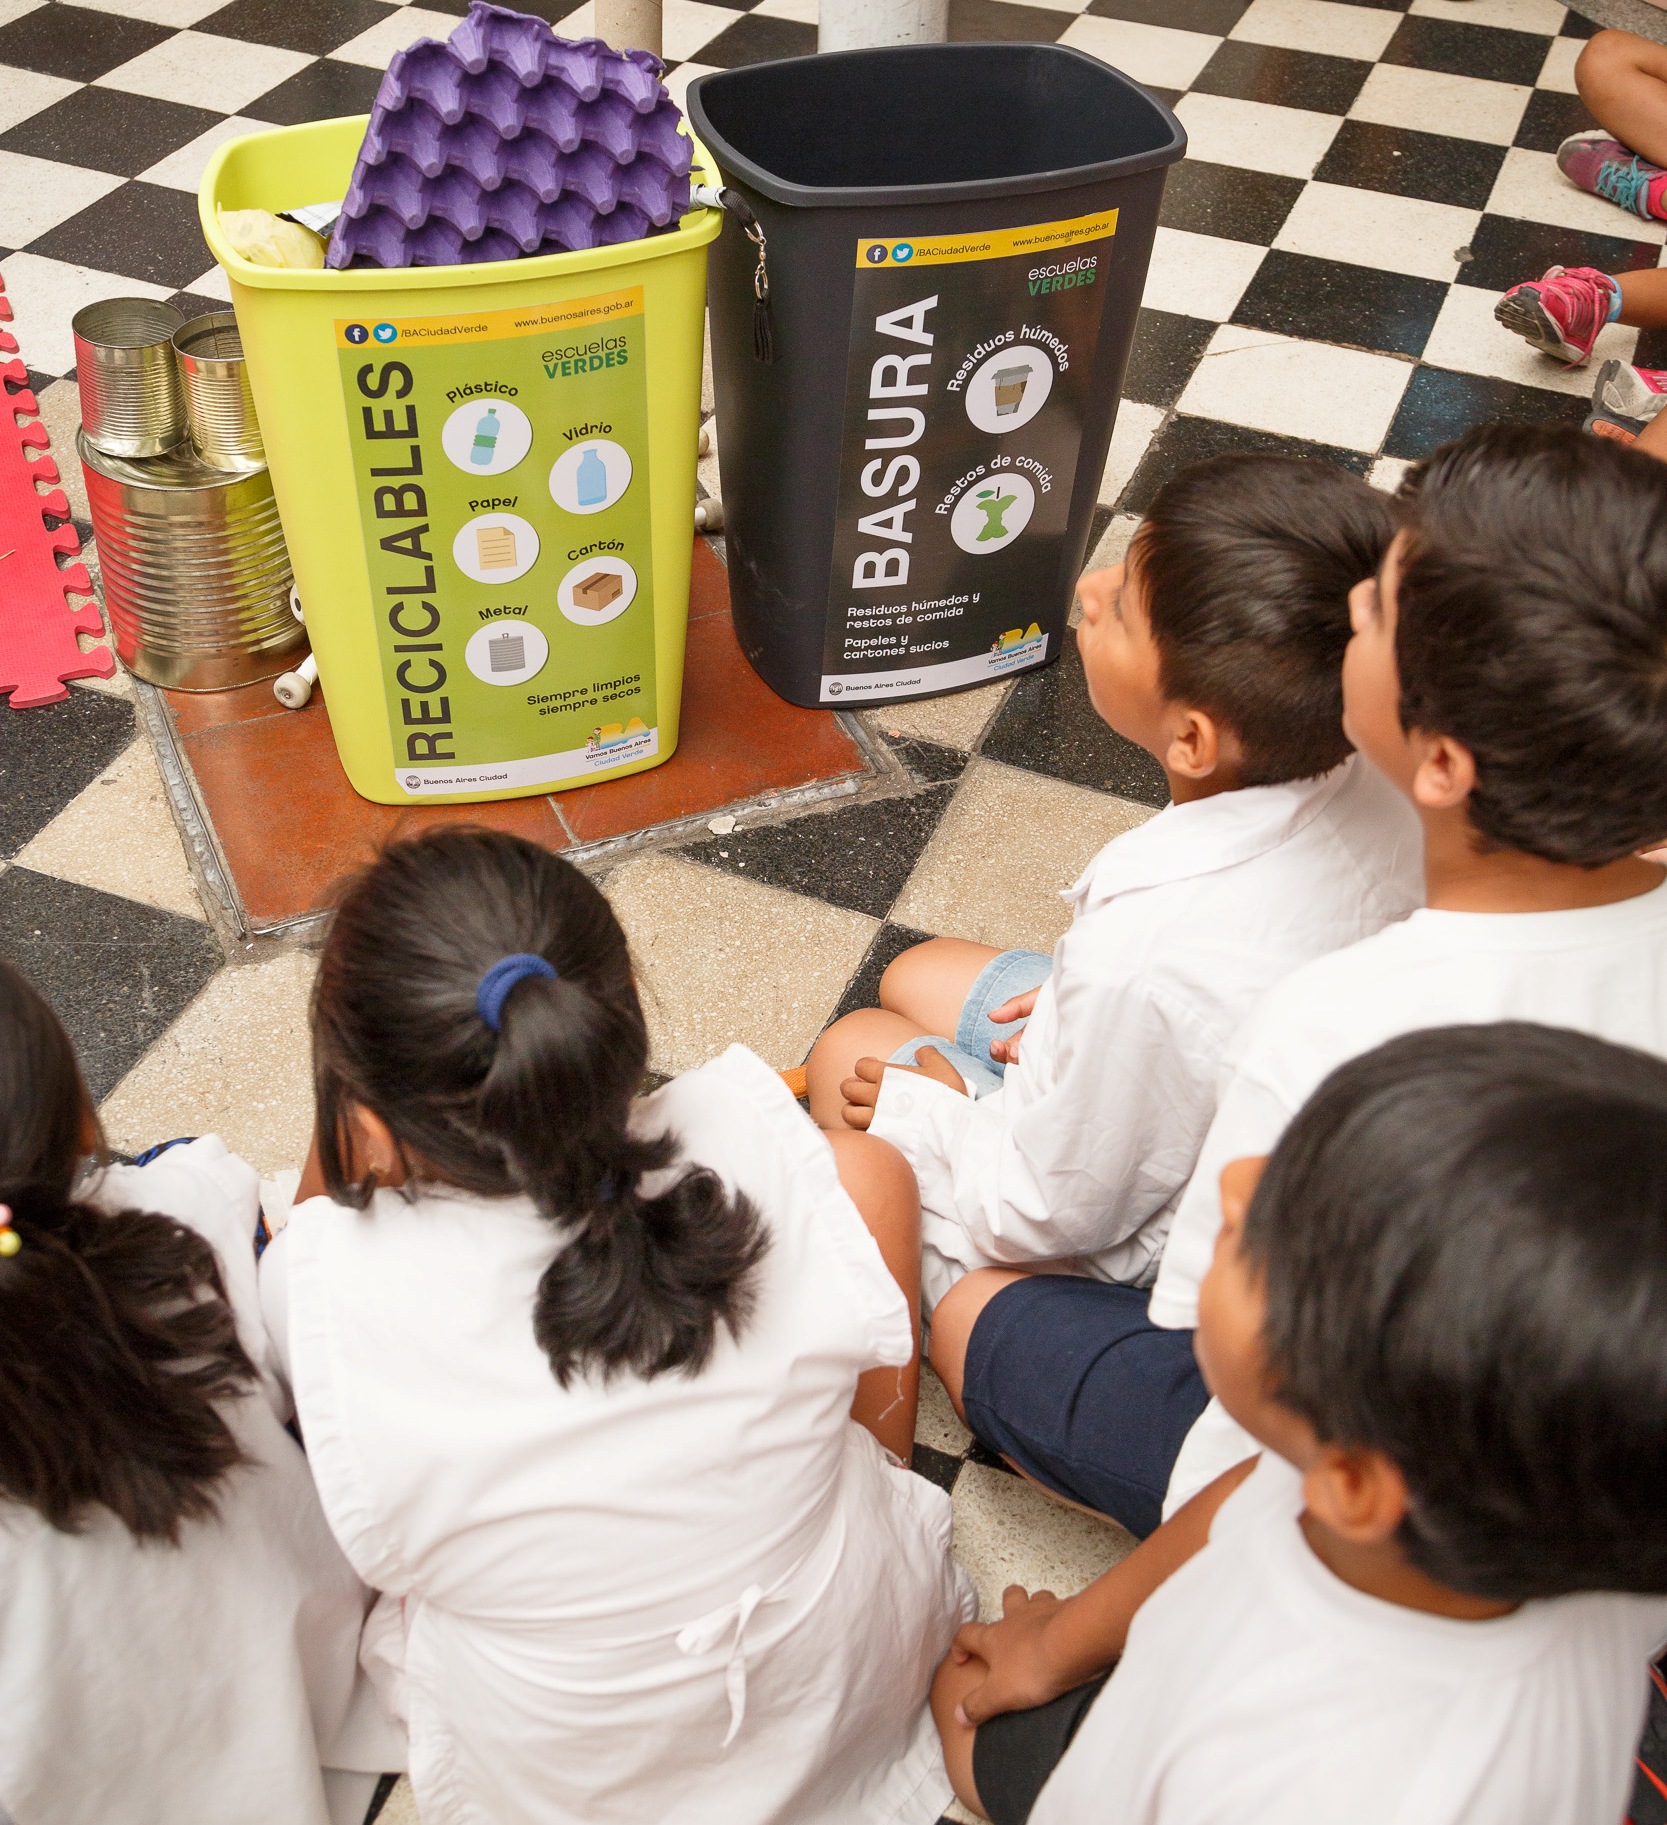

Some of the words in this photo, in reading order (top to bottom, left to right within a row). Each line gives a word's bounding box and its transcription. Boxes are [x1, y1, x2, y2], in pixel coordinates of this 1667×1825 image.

[1012, 221, 1110, 248] www.buenosaires.gob.ar
[915, 243, 991, 258] /BACiudadVerde
[1028, 255, 1098, 281] escuelas
[1028, 268, 1097, 296] VERDES
[514, 299, 635, 328] www.buenosaires.gob.ar
[400, 323, 488, 338] /BACiudadVerde
[541, 335, 627, 363] escuelas
[947, 329, 1015, 391] Residuos
[1020, 324, 1069, 372] húmedos
[543, 349, 629, 379] VERDES
[446, 381, 519, 403] Plástico
[563, 421, 613, 441] Vidrio
[852, 294, 939, 589] BASURA
[935, 463, 986, 515] Restos
[990, 455, 1012, 469] de
[1015, 456, 1053, 494] comida
[468, 496, 518, 512] Papel
[356, 360, 456, 761] RECICLABLES
[567, 539, 625, 561] Cartón
[478, 605, 529, 621] Metal
[847, 604, 907, 617] Residuos
[911, 594, 969, 612] húmedos
[972, 592, 980, 602] y
[846, 616, 892, 629] restos
[896, 613, 913, 624] de
[917, 607, 964, 623] comida
[843, 646, 906, 660] cartones
[910, 639, 950, 655] sucios
[844, 634, 896, 650] Papeles
[901, 635, 909, 646] y
[987, 655, 1007, 665] Vamos
[1007, 649, 1027, 659] Buenos
[1028, 643, 1042, 653] Aires
[994, 660, 1016, 671] Ciudad
[1016, 654, 1035, 664] Verde
[527, 687, 588, 706] Siempre
[592, 674, 641, 693] limpios
[846, 684, 873, 692] Buenos
[874, 681, 894, 689] Aires
[896, 678, 922, 687] Ciudad
[539, 697, 598, 716] siempre
[602, 686, 641, 703] secos
[585, 750, 608, 760] Vamos
[609, 743, 633, 755] Buenos
[634, 738, 652, 748] Aires
[593, 754, 621, 767] Ciudad
[621, 748, 644, 759] Verde
[455, 776, 477, 784] Aires
[479, 773, 508, 782] Ciudad
